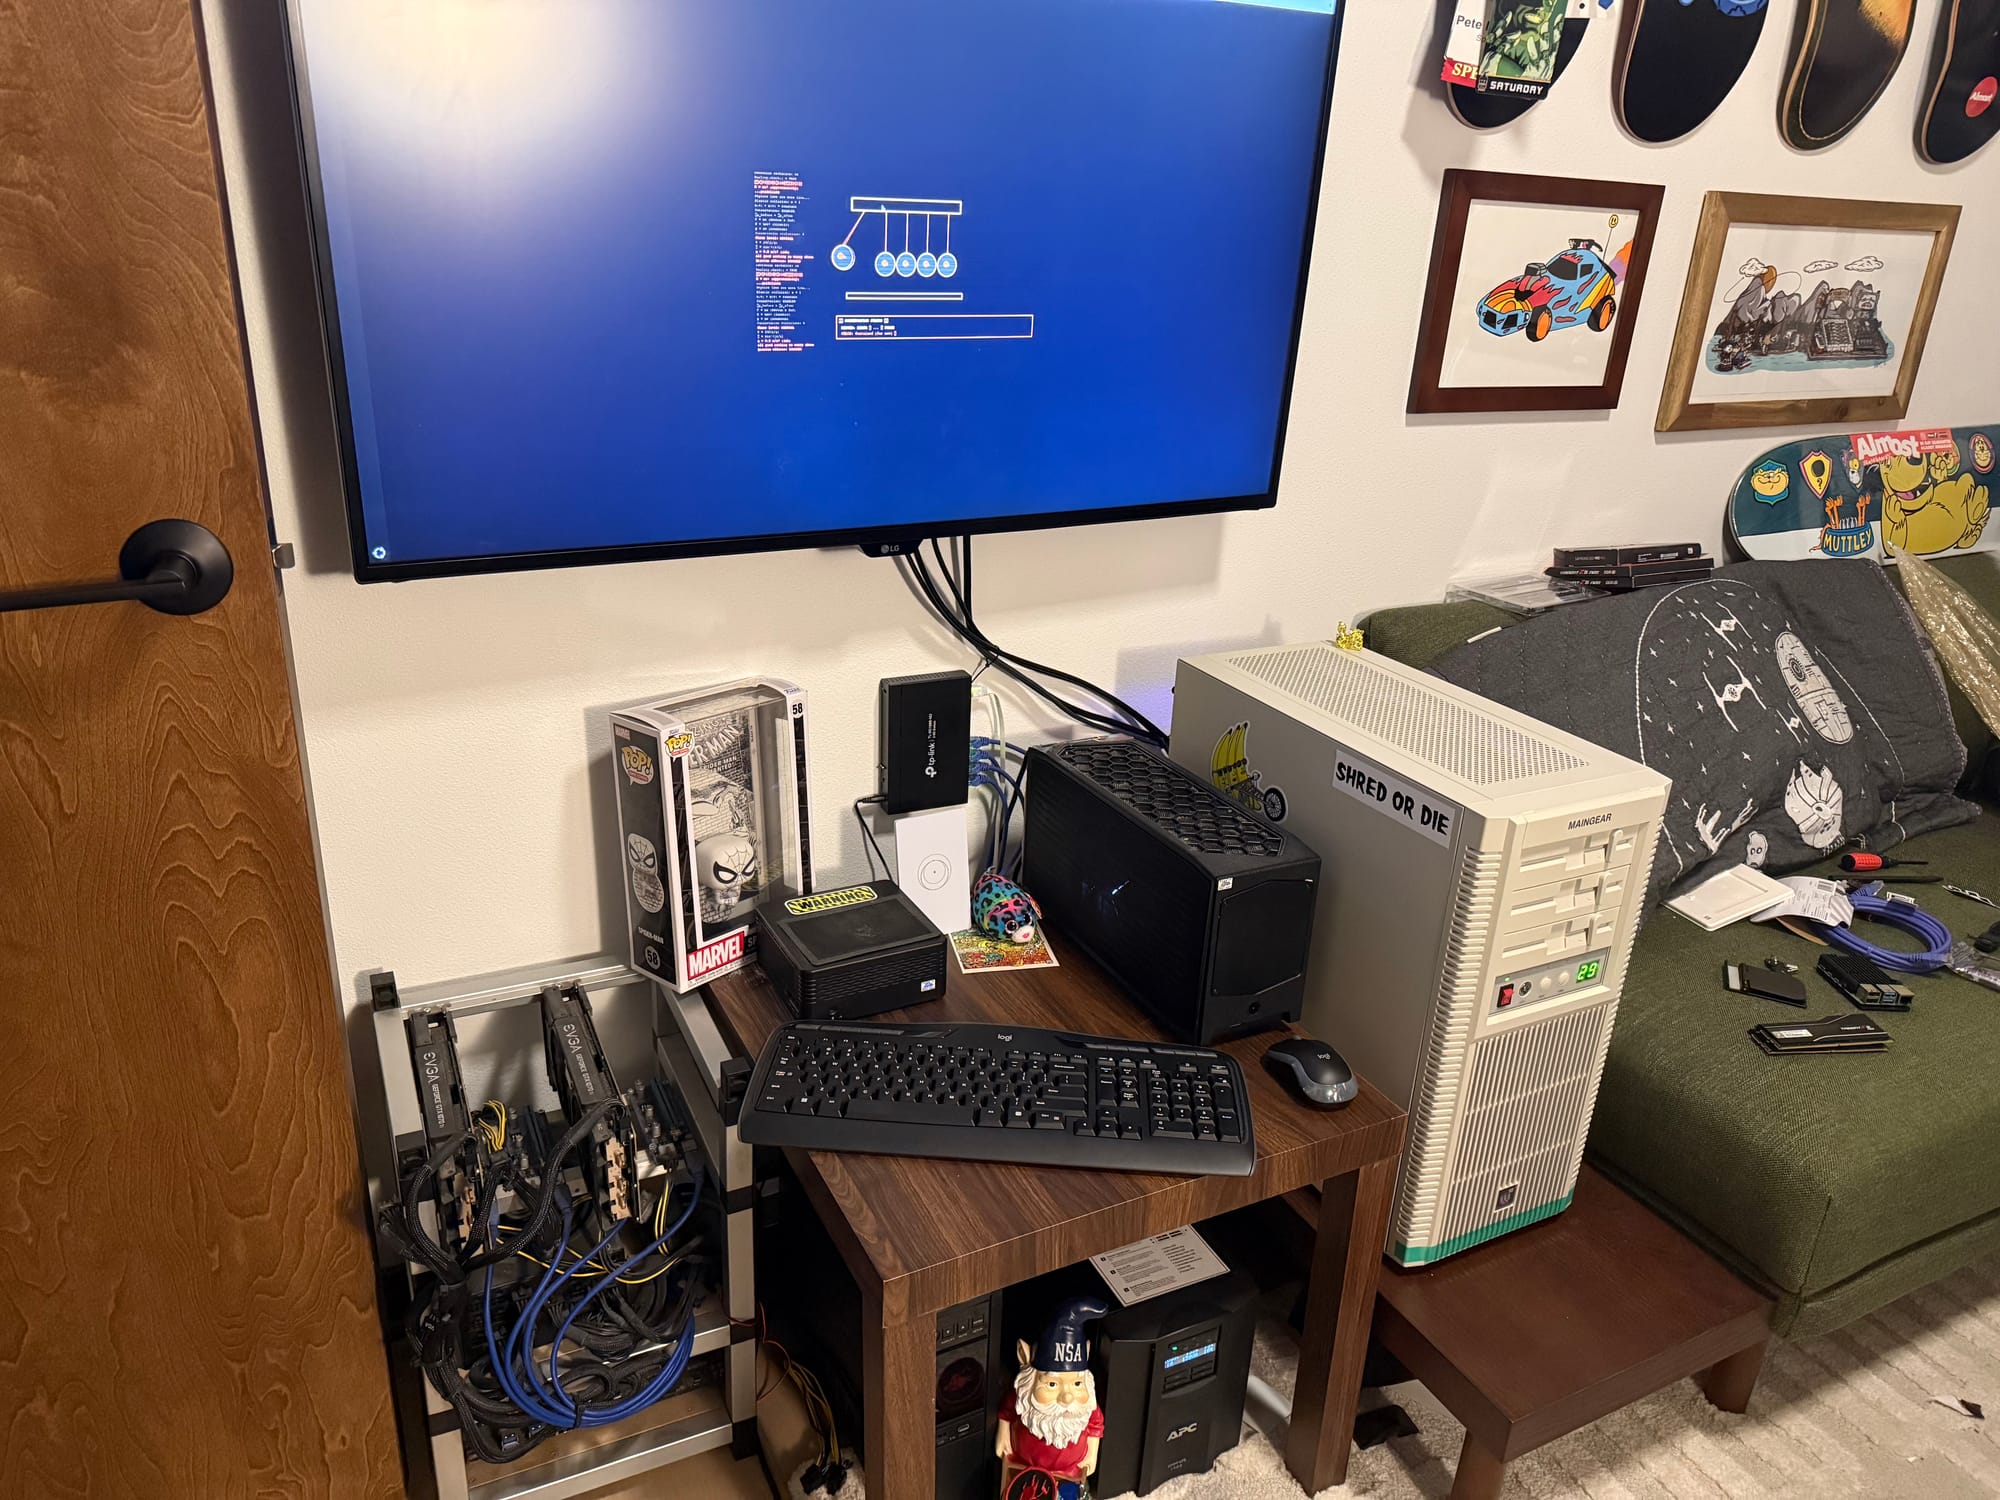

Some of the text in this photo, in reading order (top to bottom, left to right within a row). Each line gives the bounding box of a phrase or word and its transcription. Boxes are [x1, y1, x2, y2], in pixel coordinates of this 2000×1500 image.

[1456, 14, 1482, 30] Pete
[1489, 80, 1544, 95] SATURDAY
[1857, 433, 1921, 460] Almost
[889, 544, 900, 552] LG
[1823, 529, 1871, 553] MUTTLEY
[792, 702, 803, 715] 58
[664, 733, 693, 753] POP!
[621, 746, 653, 776] POP!
[927, 742, 937, 766] tp-link
[1335, 761, 1451, 836] SHRED OR DIE
[1567, 812, 1613, 830] MAINGEAR
[799, 890, 866, 909] WARNING
[646, 950, 658, 962] 58
[688, 935, 744, 978] MARVEL
[1577, 961, 1599, 981] 29
[563, 1023, 582, 1054] EVGA
[997, 1033, 1013, 1042] logi
[423, 1051, 441, 1084] EVGA
[1054, 1342, 1082, 1362] NSA
[1166, 1422, 1198, 1442] APC
